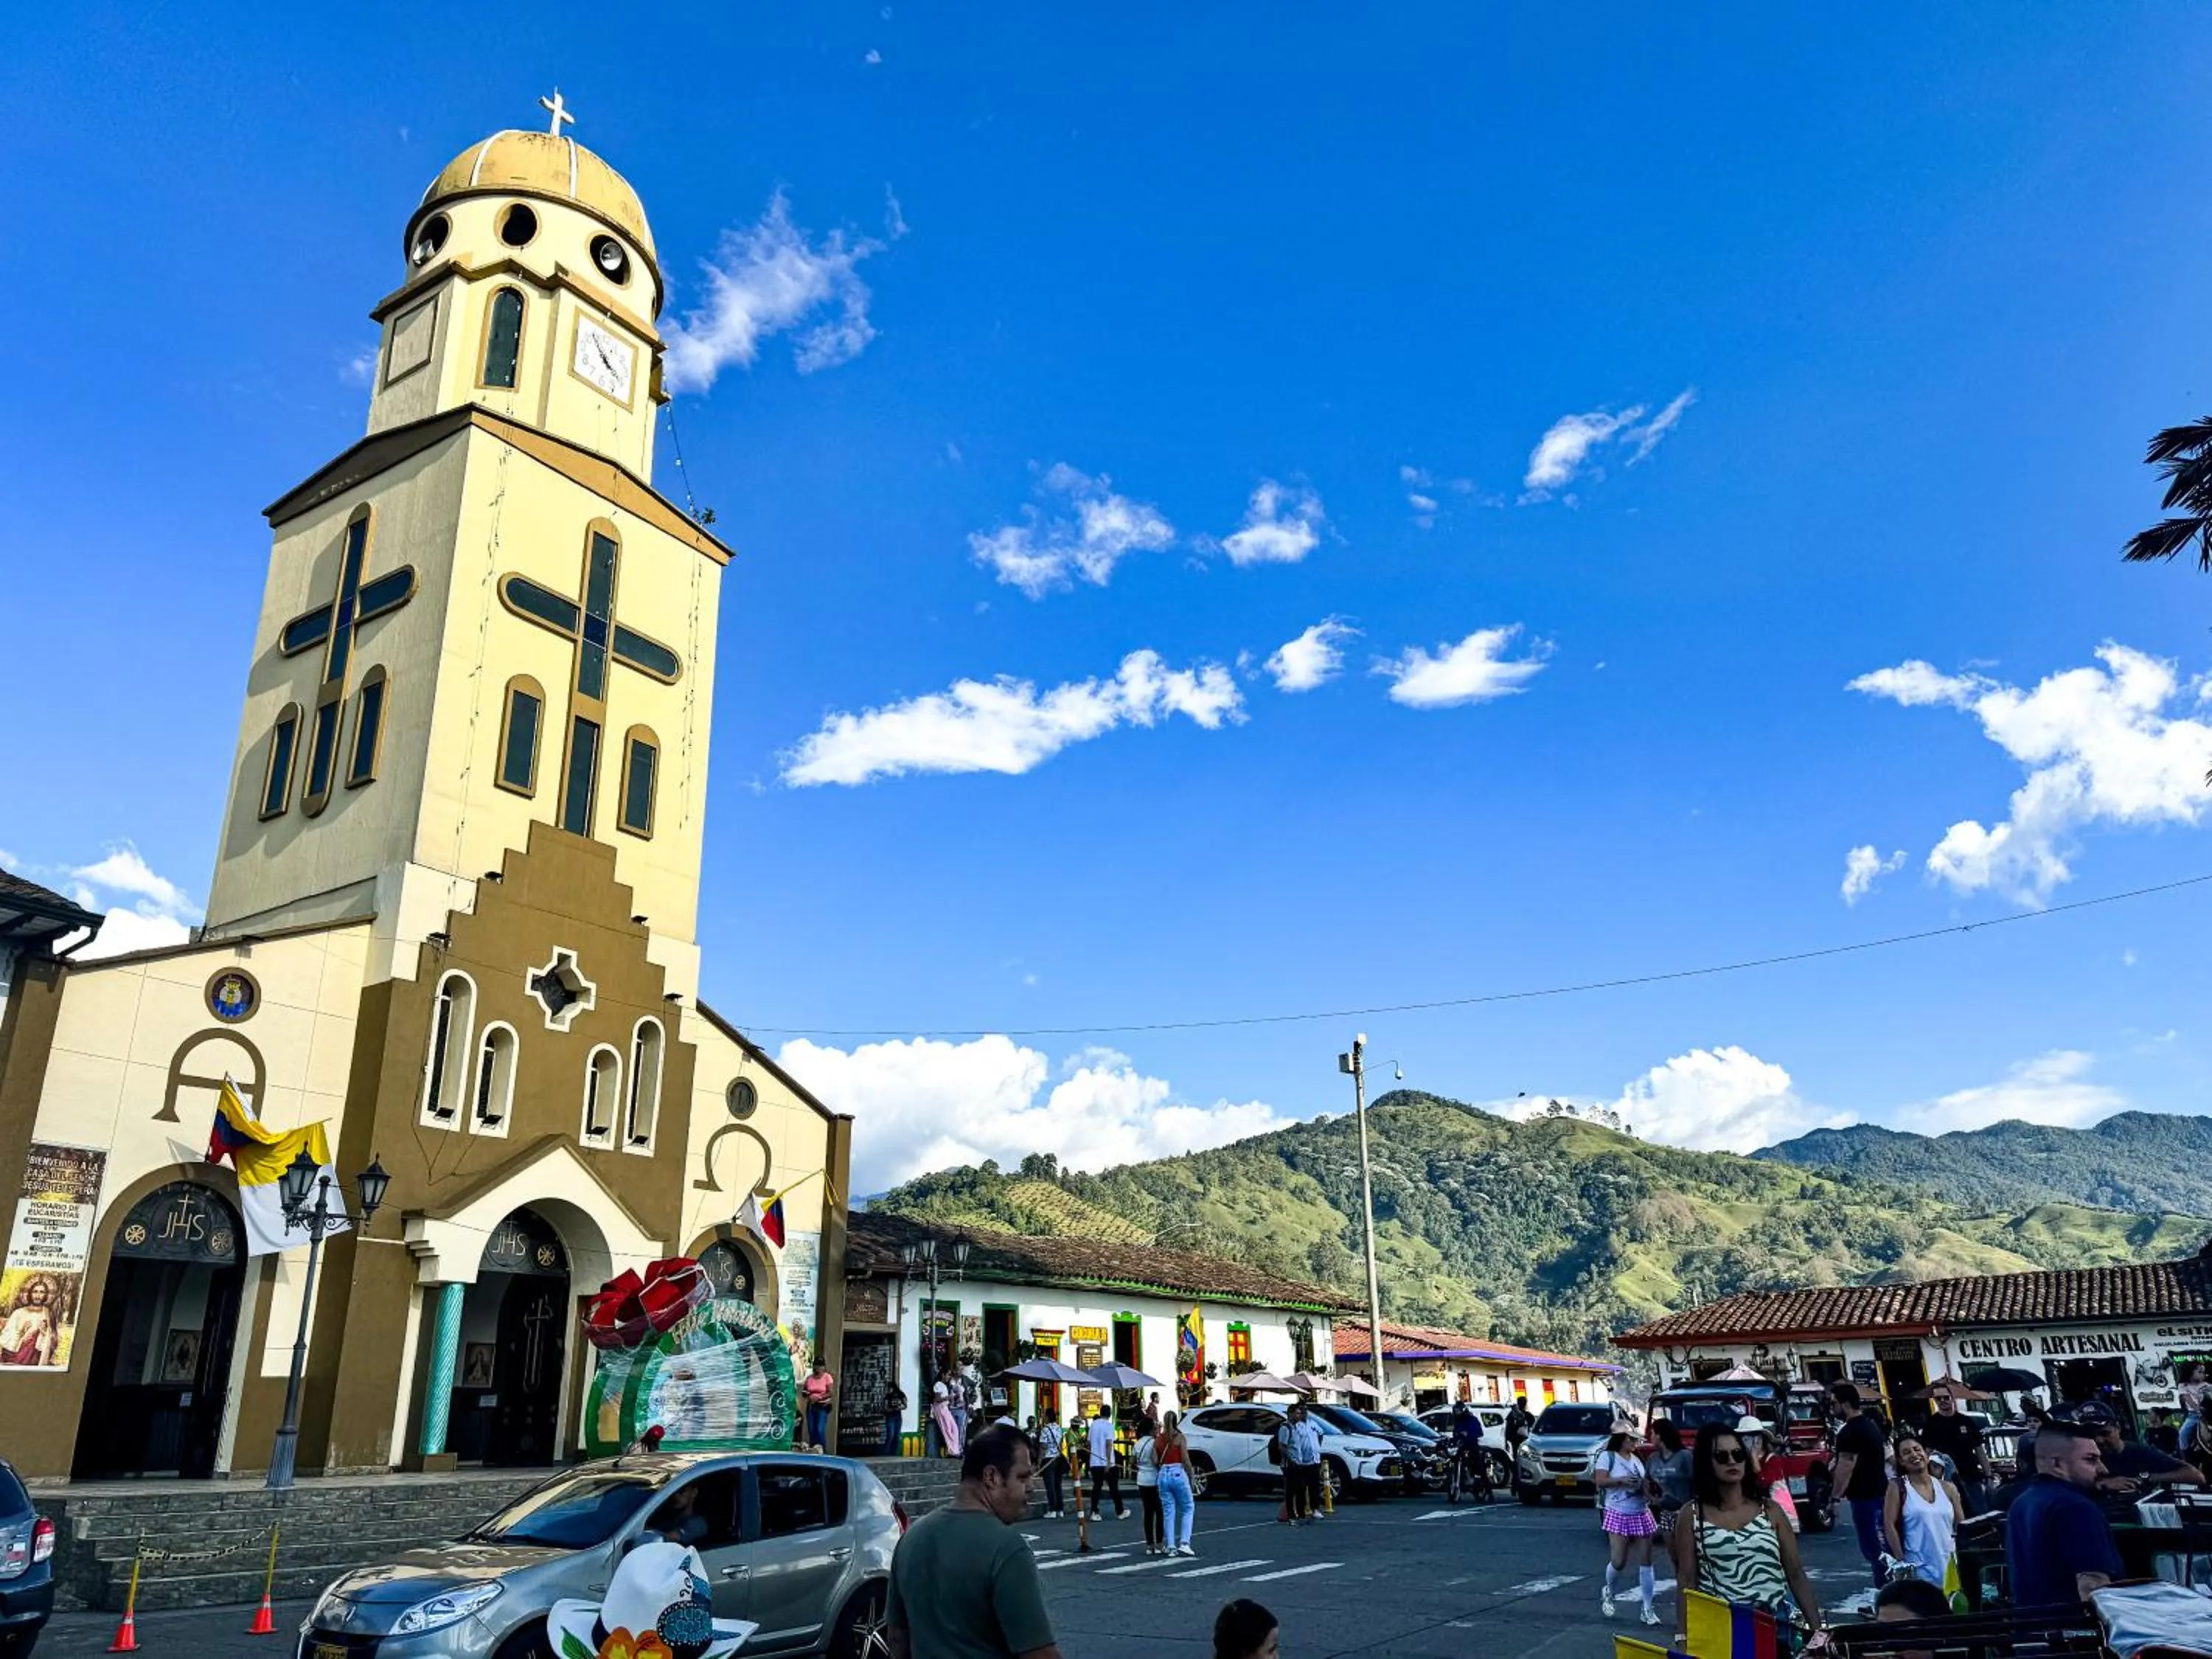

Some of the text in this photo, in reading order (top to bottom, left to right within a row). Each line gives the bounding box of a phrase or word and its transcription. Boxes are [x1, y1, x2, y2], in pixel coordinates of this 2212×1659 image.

[27, 1168, 49, 1178] CASA
[80, 1161, 87, 1171] A
[30, 1201, 67, 1210] HORARIO
[157, 1211, 205, 1241] JHS
[493, 1231, 526, 1256] JHS
[1958, 1332, 2145, 1359] CENTRO ARTESANAL
